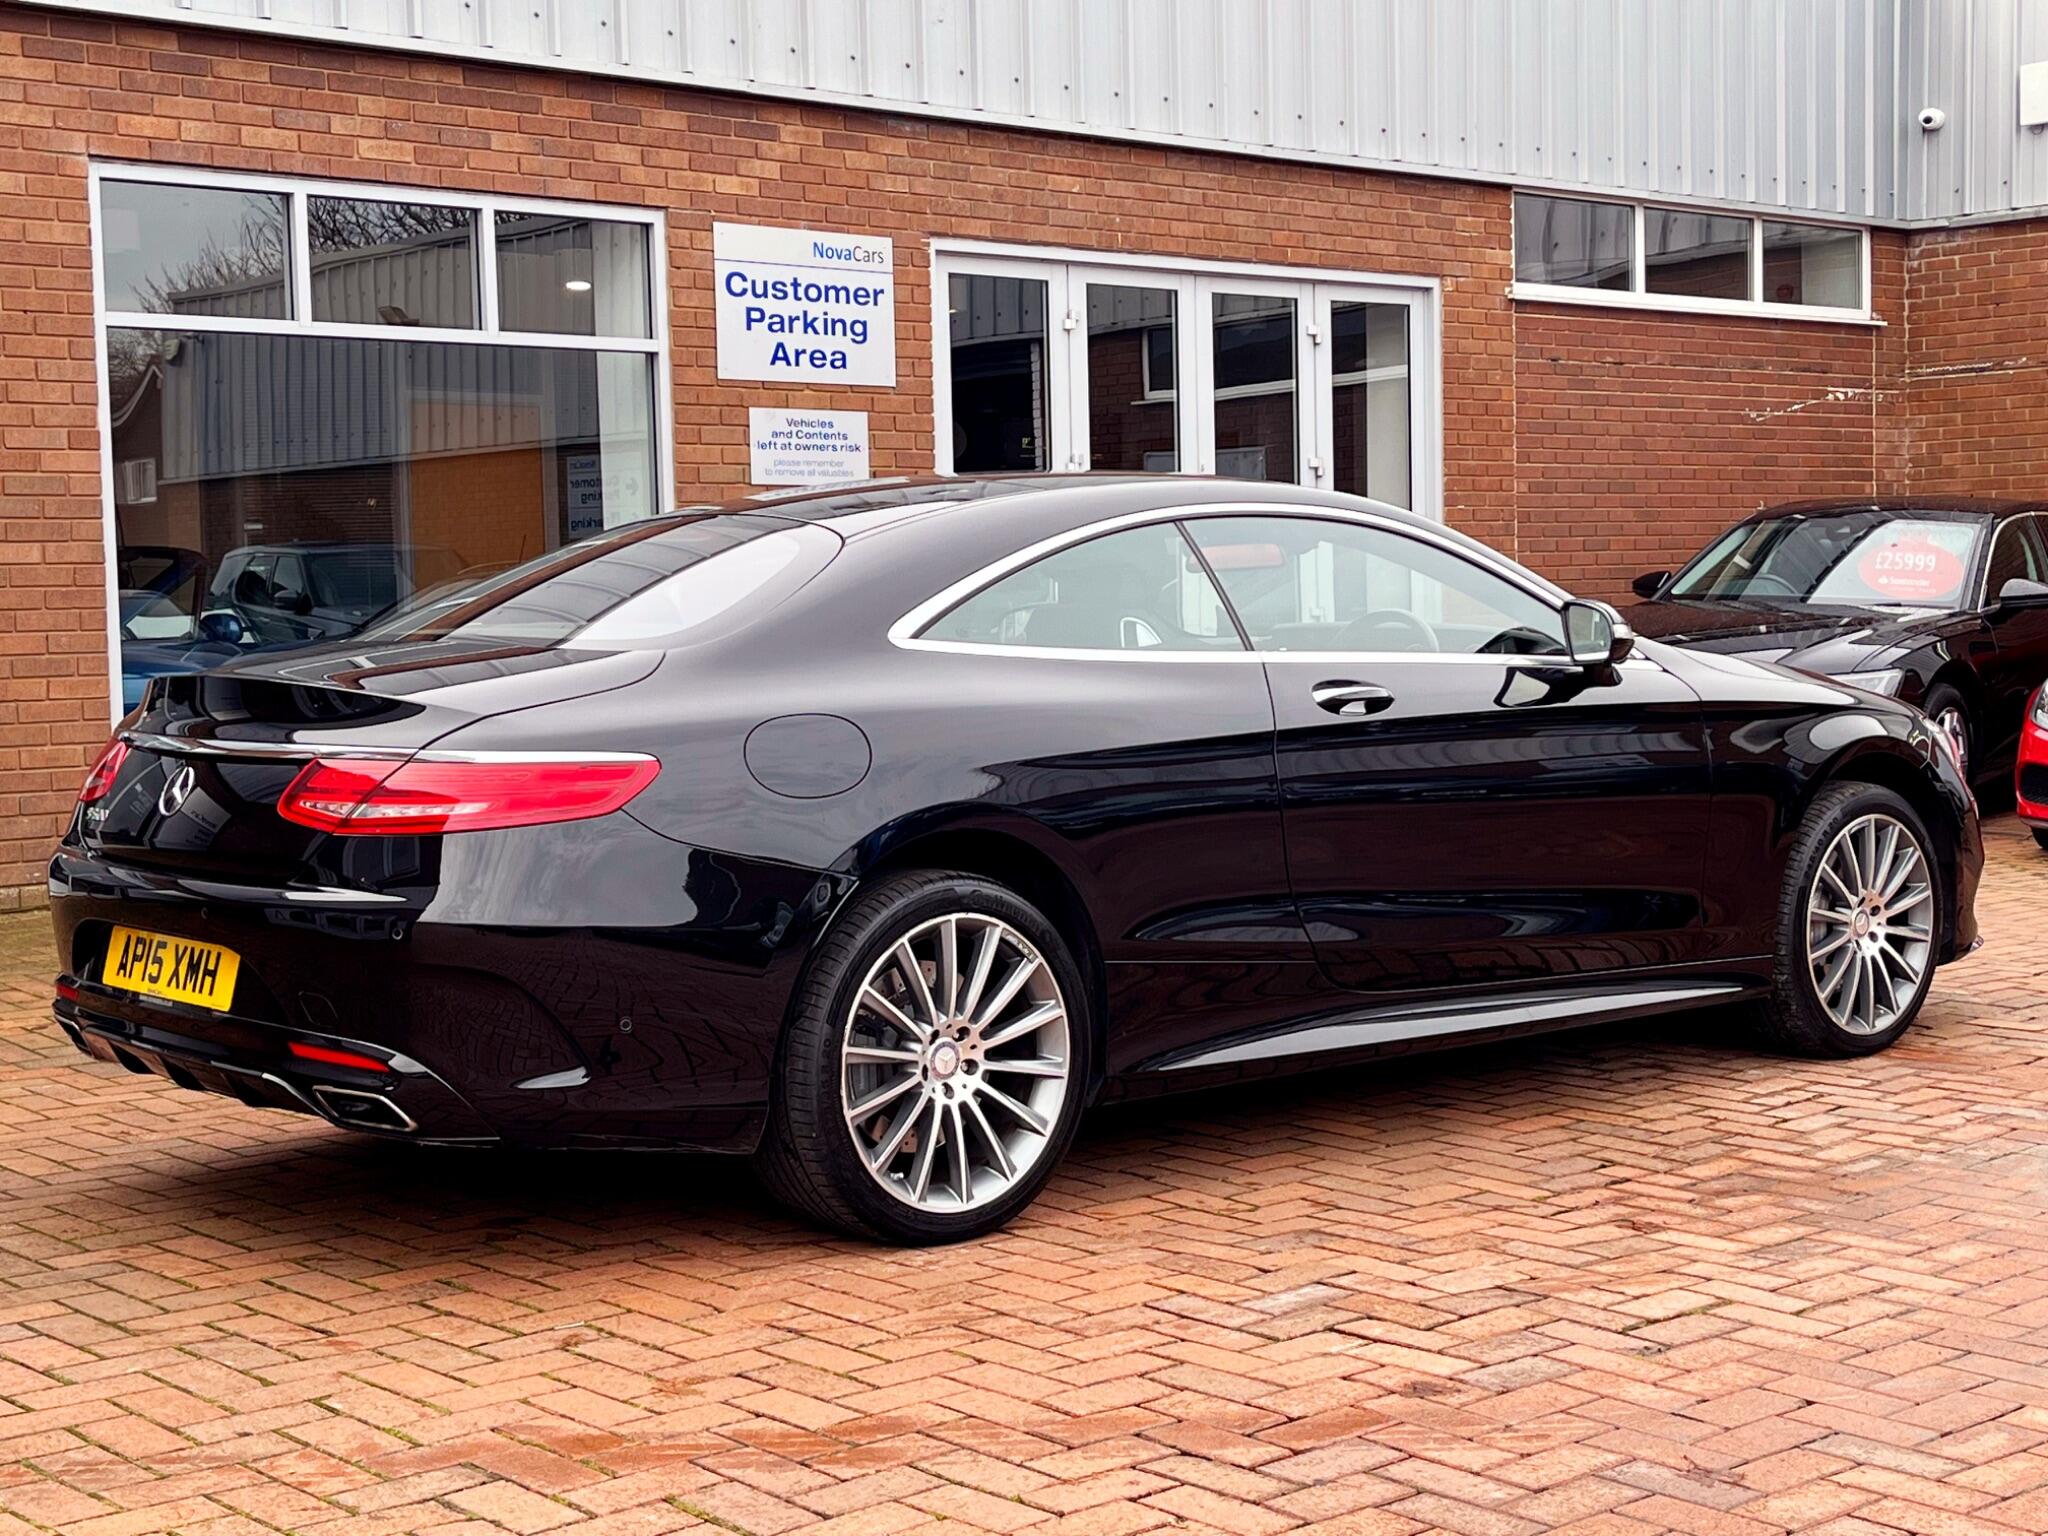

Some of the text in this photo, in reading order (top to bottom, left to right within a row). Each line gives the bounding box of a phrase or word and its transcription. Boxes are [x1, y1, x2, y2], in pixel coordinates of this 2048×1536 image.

[813, 242, 884, 264] NovaCars
[725, 271, 885, 306] Customer
[745, 306, 868, 344] Parking
[770, 342, 847, 369] Area
[785, 418, 834, 428] Vehicles
[771, 430, 848, 440] and Contents
[757, 440, 861, 452] left at owners risk
[765, 468, 773, 476] to
[775, 468, 805, 477] remove
[774, 459, 844, 468] please remember
[1875, 552, 1936, 572] £25999
[116, 933, 222, 997] AP15 XMH
